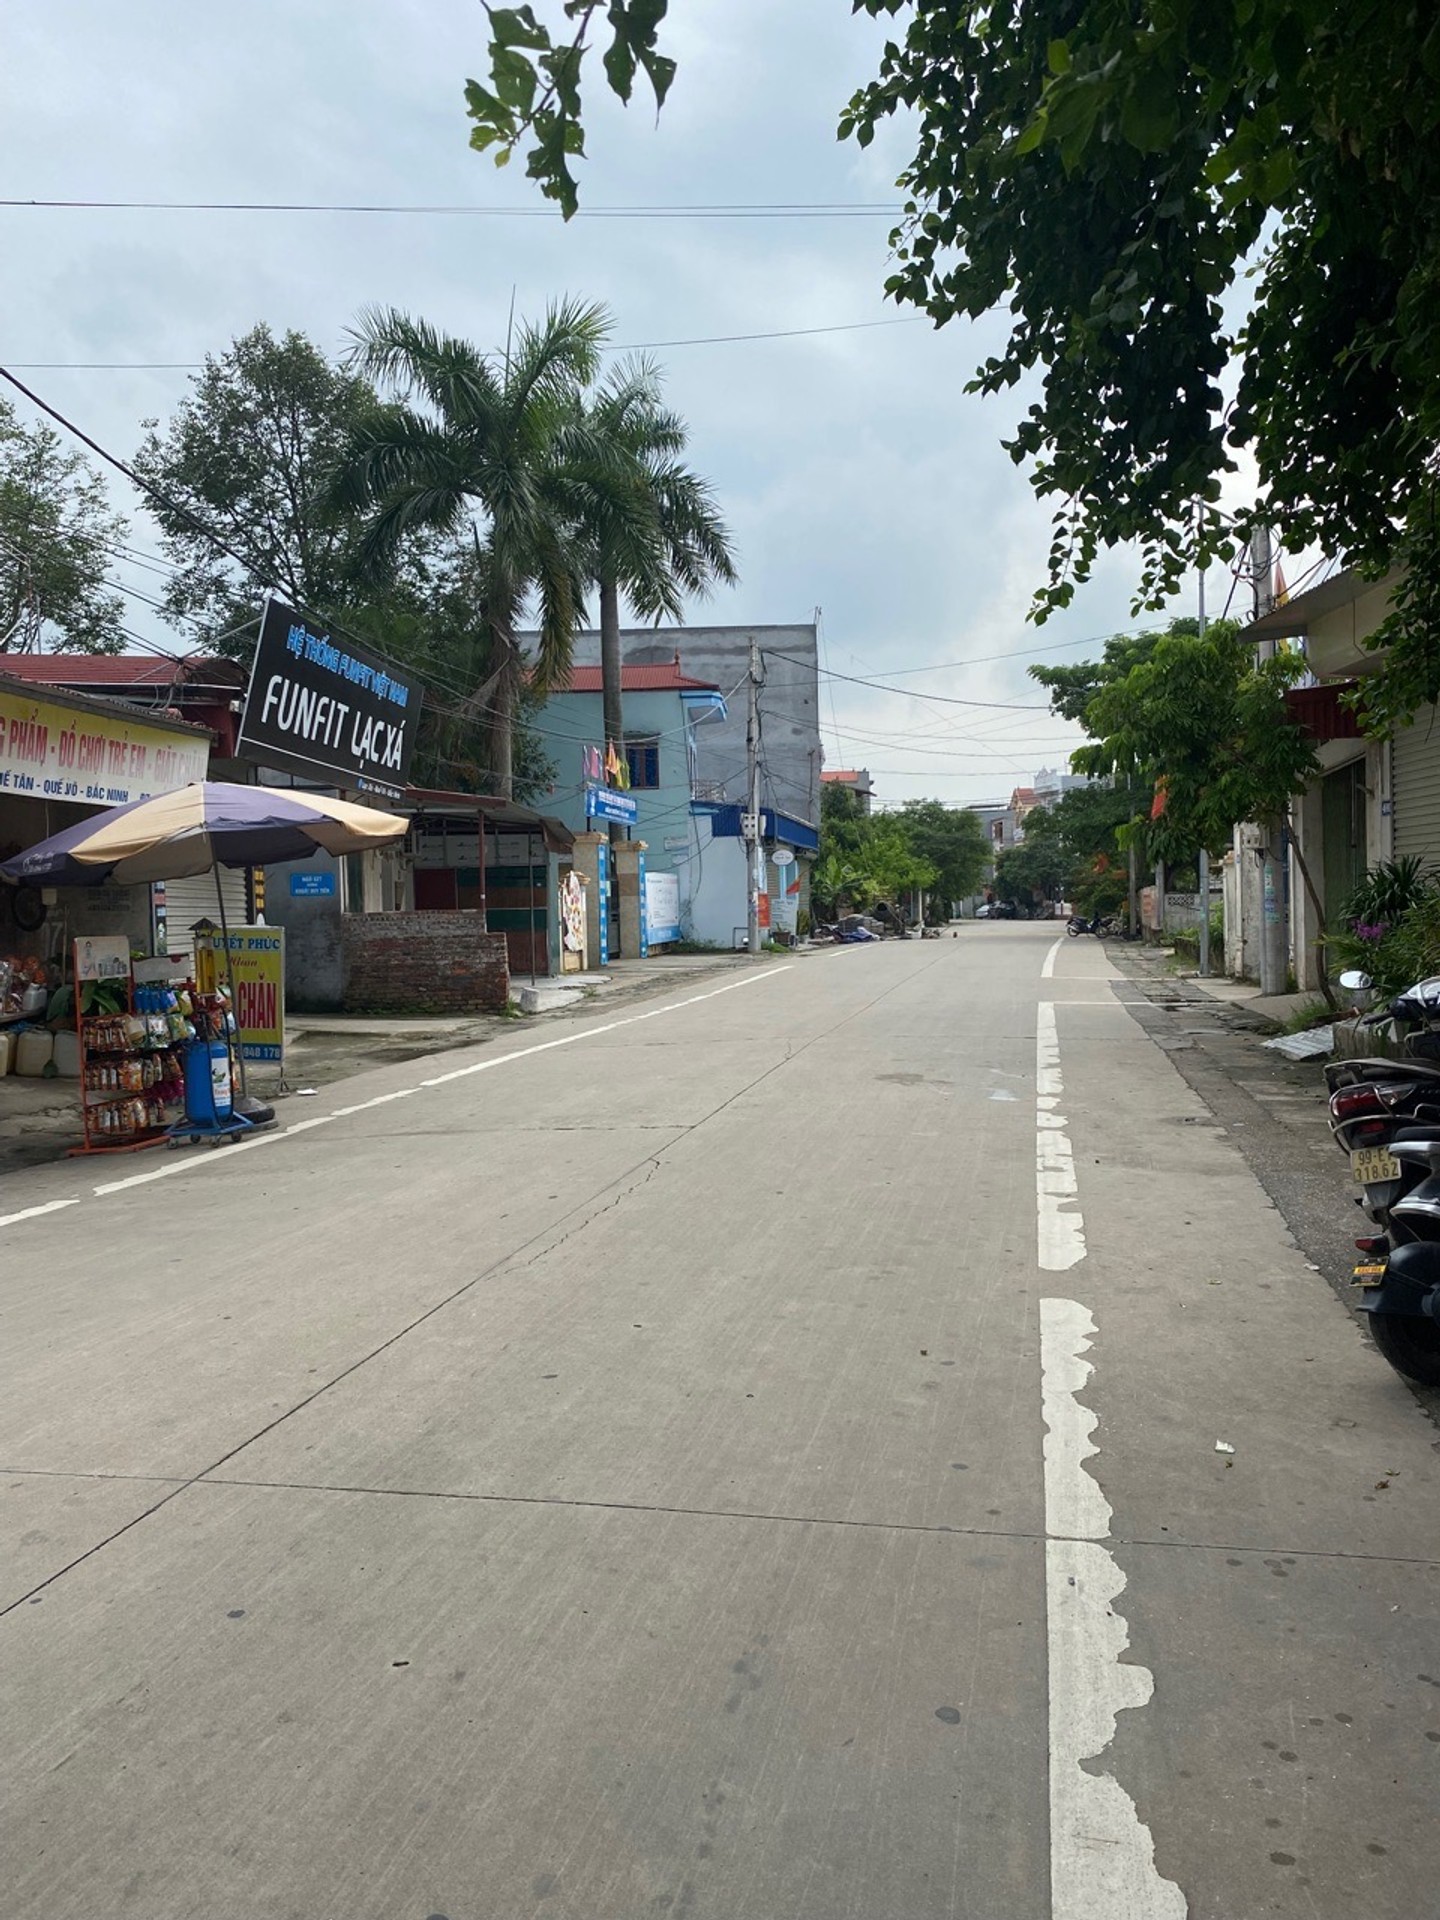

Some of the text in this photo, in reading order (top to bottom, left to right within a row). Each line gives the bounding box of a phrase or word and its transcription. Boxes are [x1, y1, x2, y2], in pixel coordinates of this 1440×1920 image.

[286, 624, 409, 708] HỆ THỐNG FUNFIT VIỆT NAM
[261, 675, 407, 771] FUNFIT LẠC XÁ
[108, 731, 128, 777] TRẺ
[129, 744, 147, 779] EM
[13, 772, 35, 790] TÂN
[43, 777, 63, 795] QUẾ
[106, 788, 129, 803] NINH
[248, 935, 281, 950] PHÚC
[238, 972, 276, 1029] CHĂN
